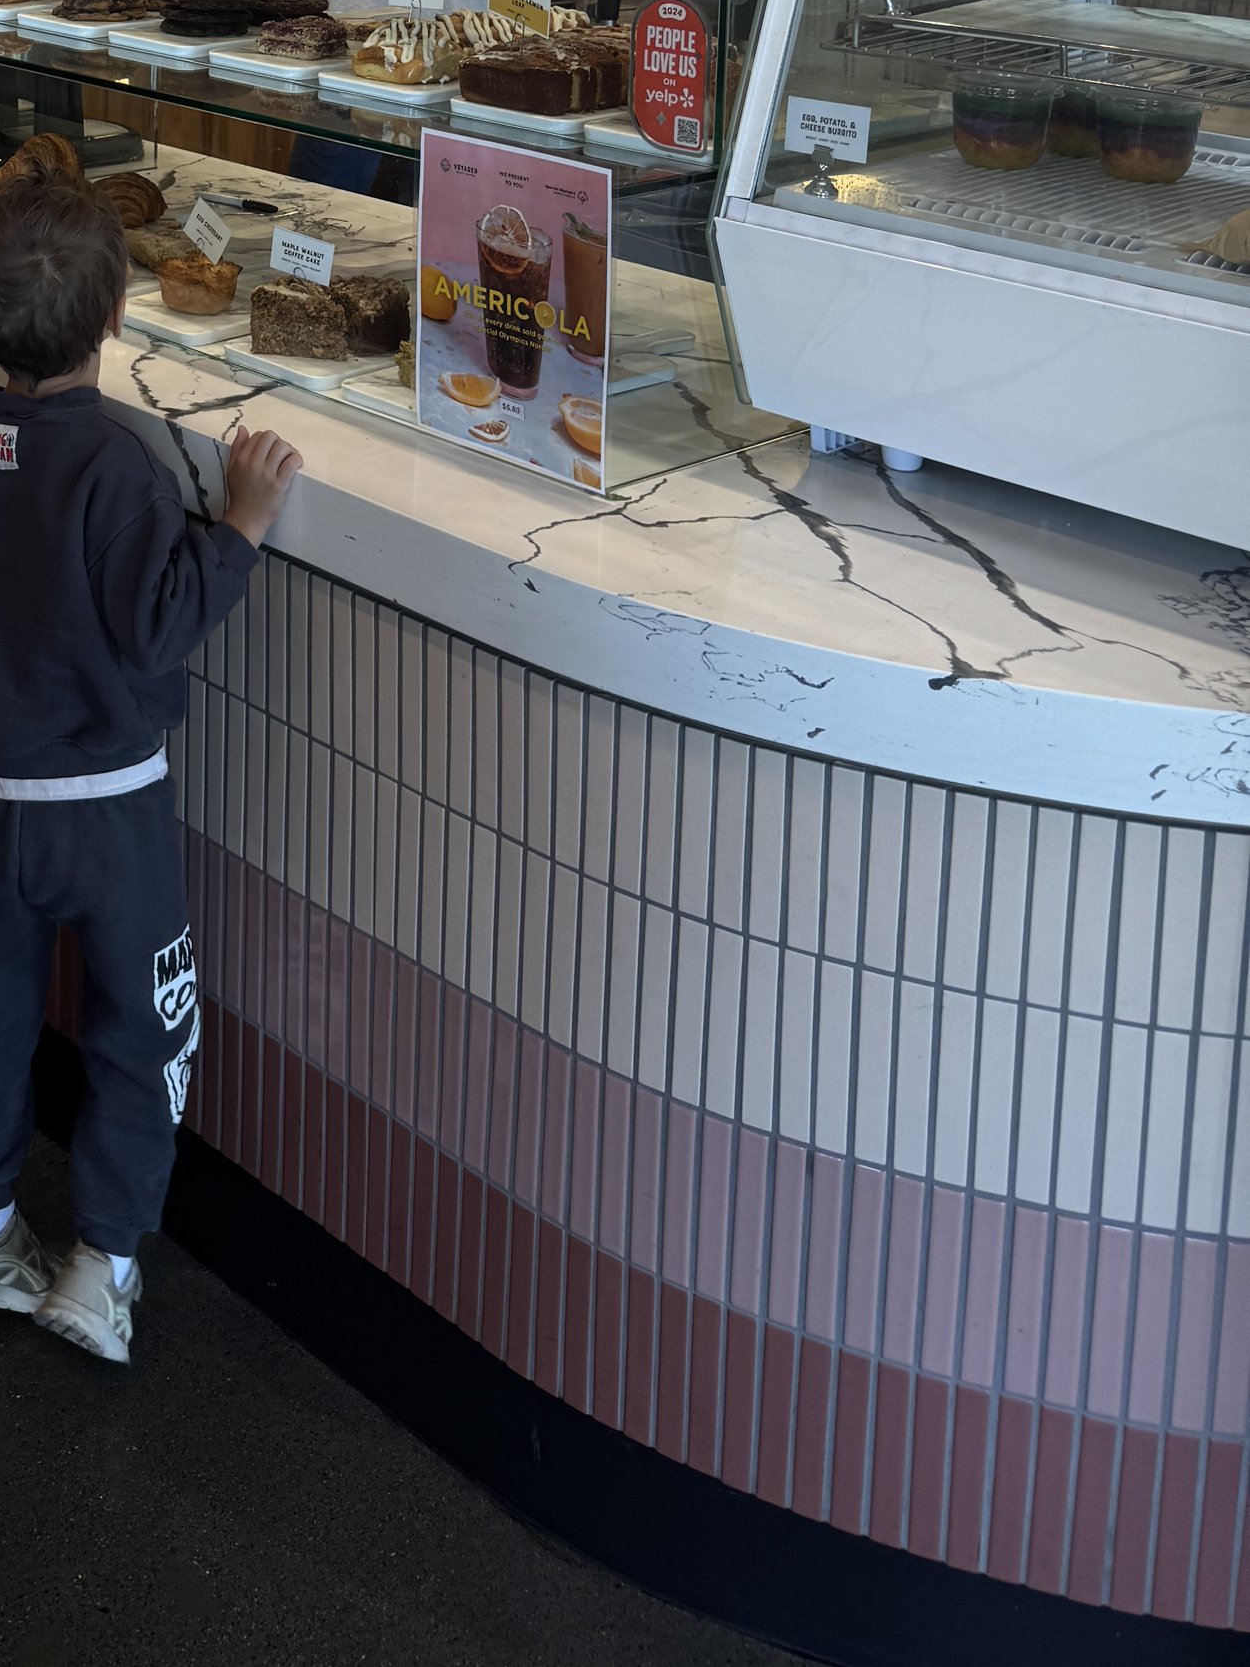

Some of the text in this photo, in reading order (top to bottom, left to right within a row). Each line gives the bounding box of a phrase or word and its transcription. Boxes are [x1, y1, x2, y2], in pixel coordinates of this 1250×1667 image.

[662, 6, 683, 18] 2024
[646, 25, 696, 54] PEOPLE
[643, 49, 697, 79] LOVE US
[663, 77, 676, 87] ON
[645, 88, 679, 107] yelp
[802, 113, 818, 123] EGG,
[819, 116, 848, 128] POTATO,
[800, 122, 857, 139] CHEESE BURRITO
[454, 163, 478, 174] VOYAGER
[508, 173, 530, 182] PRESENT
[281, 240, 325, 260] MAPLE WALNUT
[283, 249, 304, 261] COFFEE
[305, 255, 321, 266] CAKE
[485, 317, 536, 338] every drink sold
[498, 330, 529, 346] Olympics
[502, 402, 521, 415] $6.80
